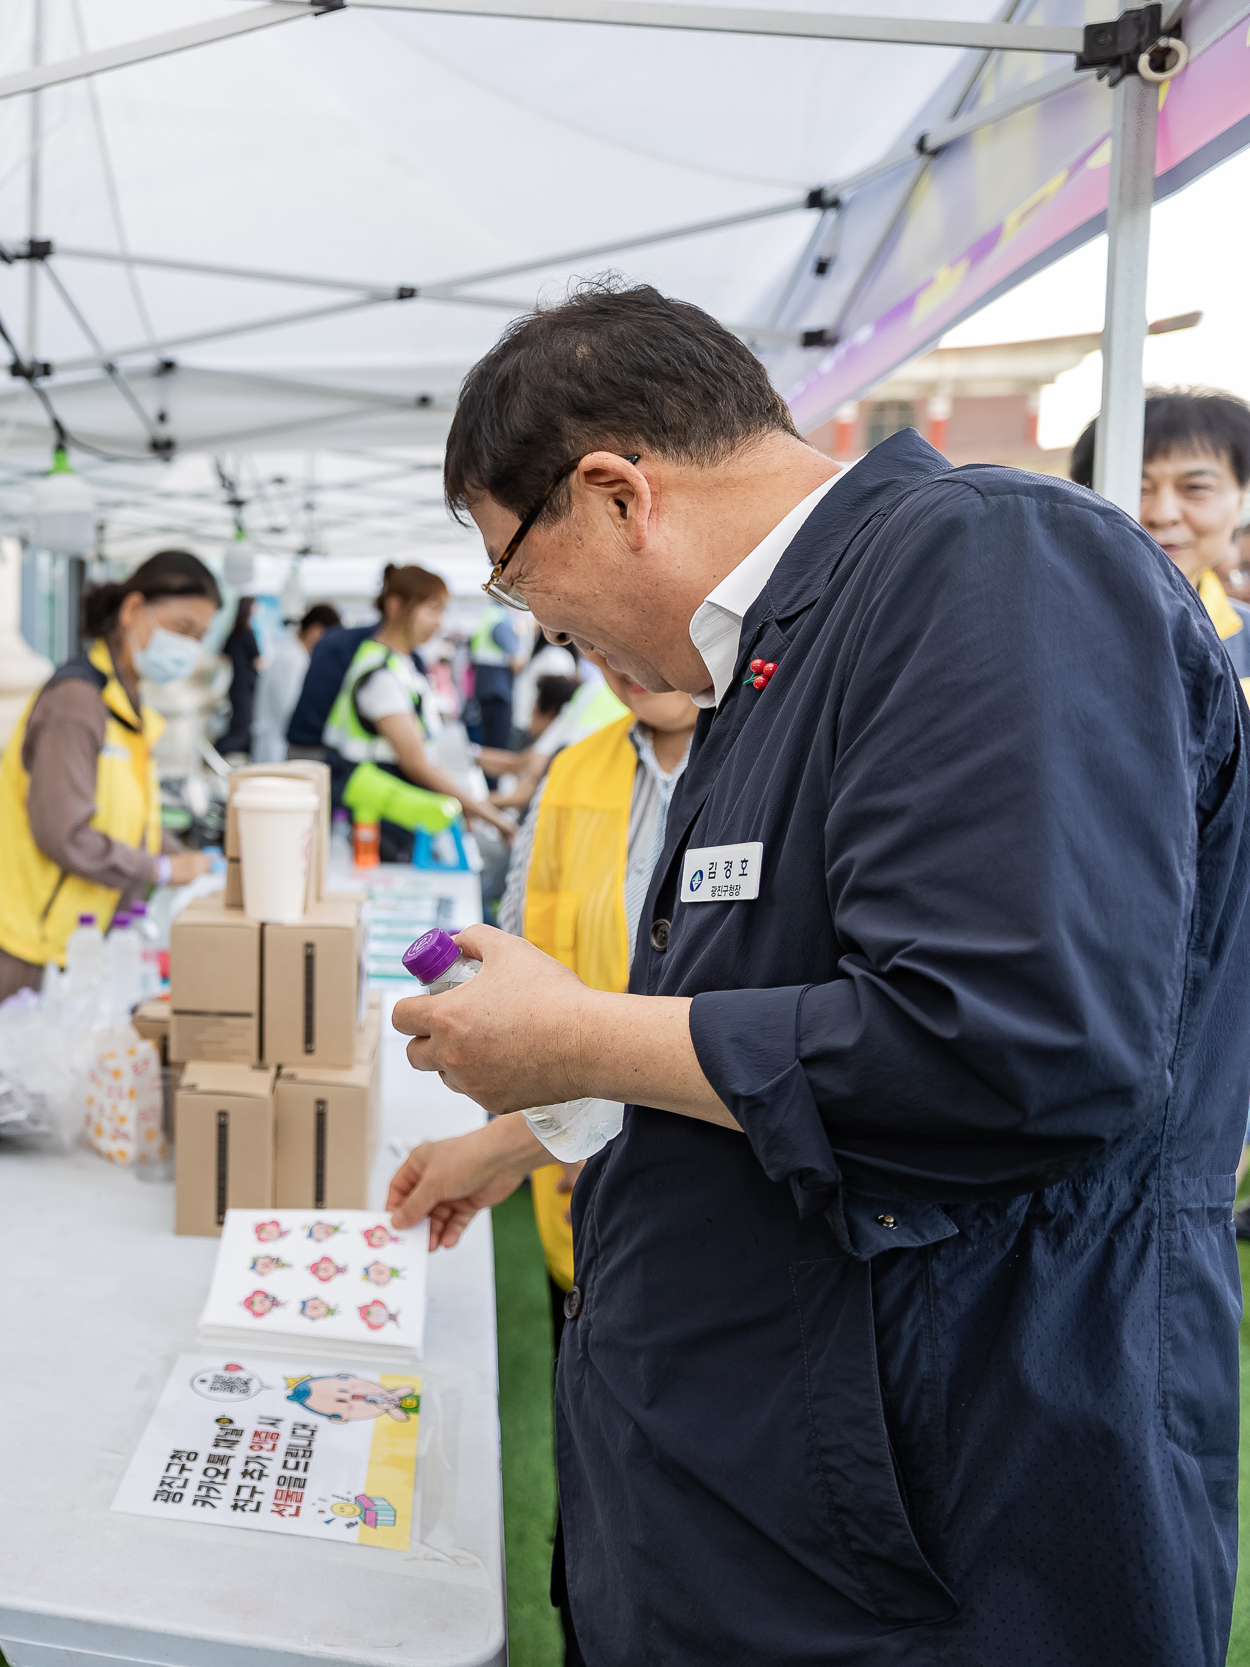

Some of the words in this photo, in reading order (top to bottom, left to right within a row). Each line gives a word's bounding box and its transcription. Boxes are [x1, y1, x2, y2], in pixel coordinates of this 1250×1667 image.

[711, 884, 742, 897] 광진구청장
[258, 1415, 283, 1429] 시
[213, 1427, 244, 1450] 채널
[249, 1430, 280, 1452] 인증
[153, 1449, 198, 1503] 광진구청
[193, 1453, 235, 1509] 카카오톡
[241, 1455, 273, 1481] 추가
[230, 1485, 265, 1512] 친구
[270, 1475, 307, 1518] 선물을
